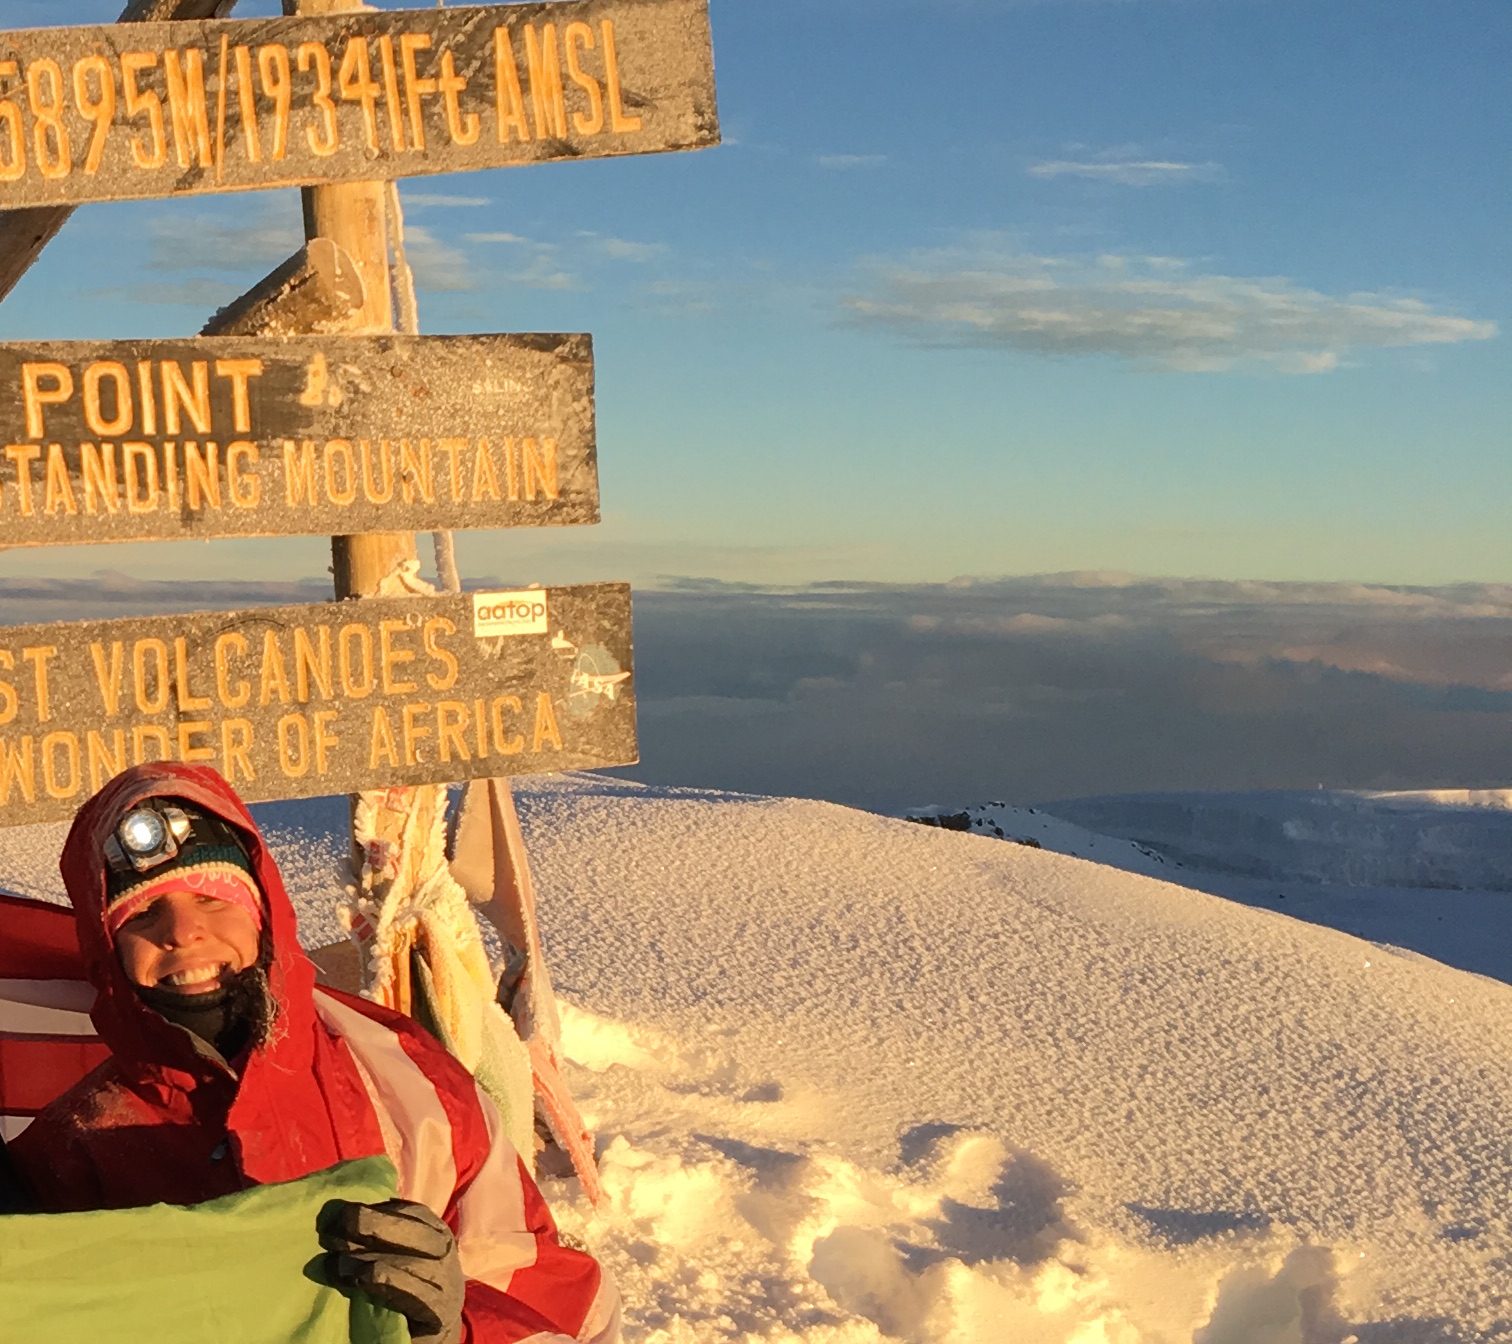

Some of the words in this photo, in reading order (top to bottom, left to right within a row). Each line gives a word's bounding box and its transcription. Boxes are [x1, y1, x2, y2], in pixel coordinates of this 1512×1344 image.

[496, 19, 642, 144] AMSL
[22, 358, 264, 440] POINT
[281, 437, 560, 508] MOUNTAIN
[477, 599, 546, 623] aatop
[88, 616, 460, 717] VOLCANOES
[278, 708, 342, 778] OF
[369, 690, 564, 772] AFRICA
